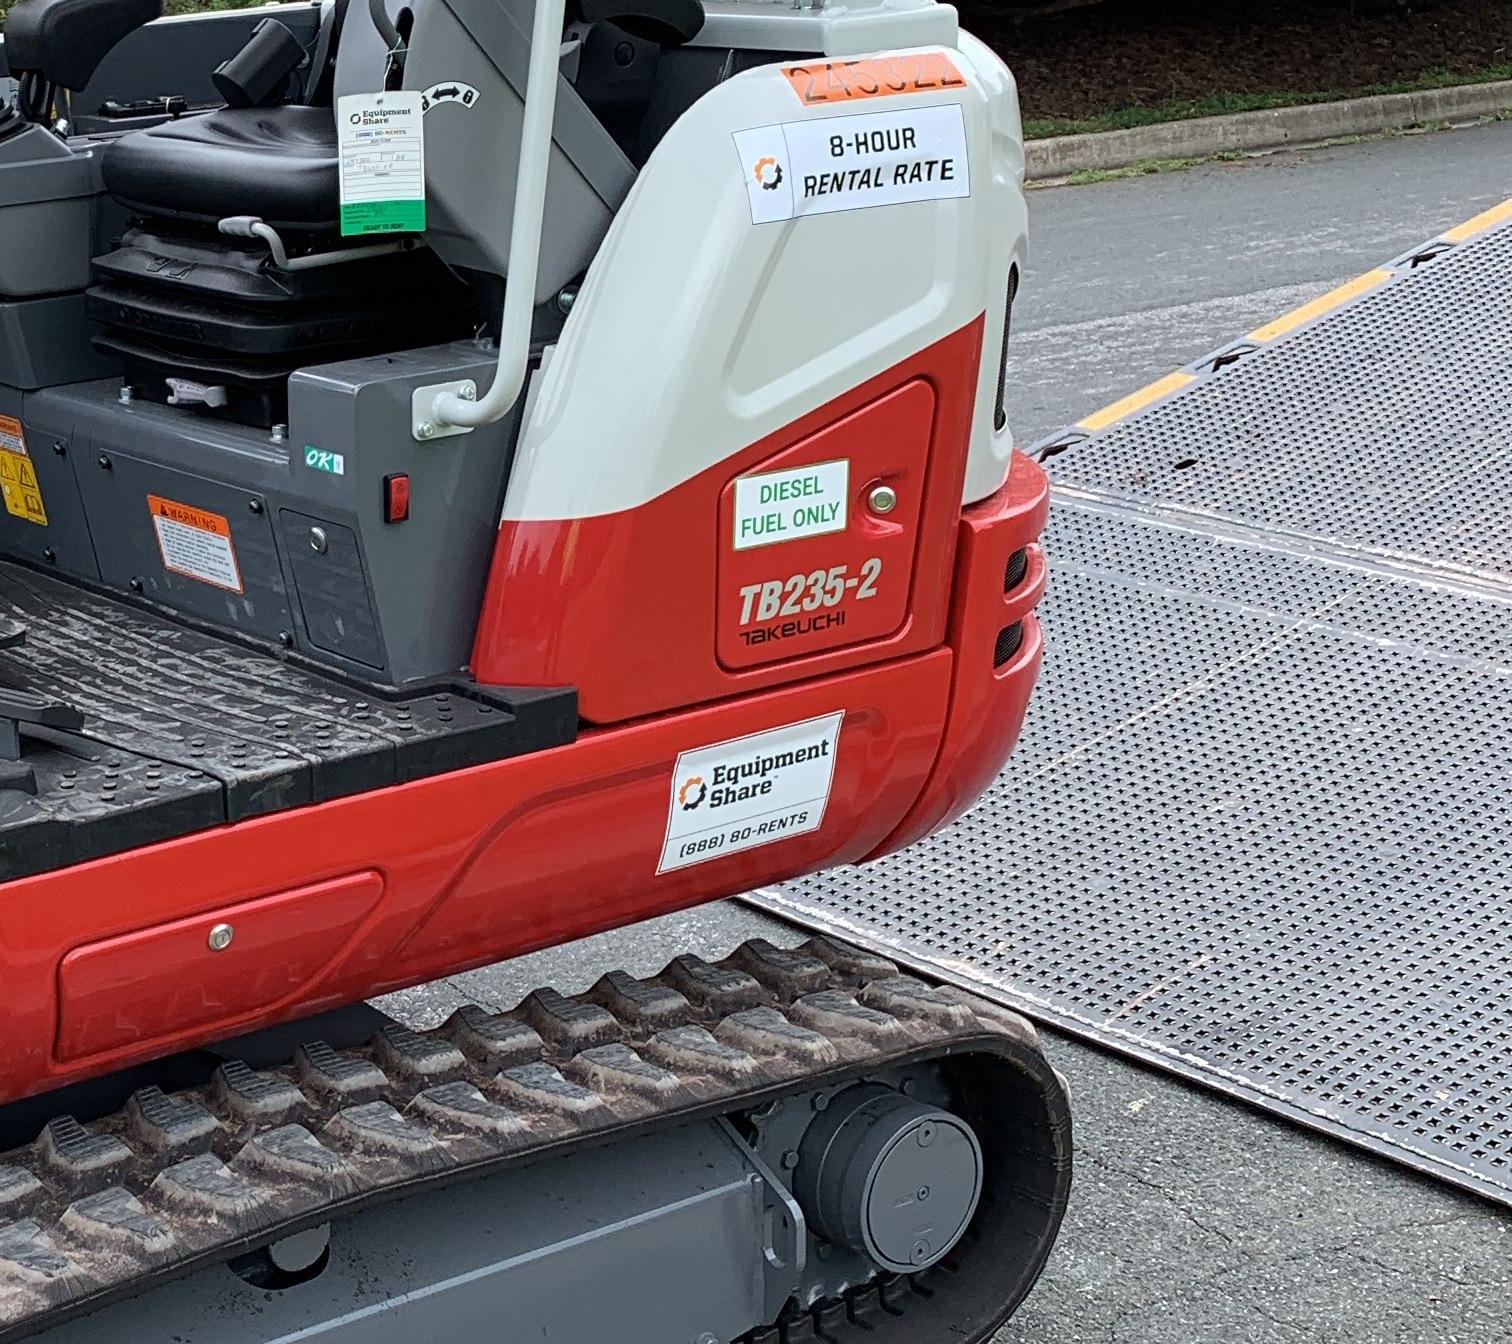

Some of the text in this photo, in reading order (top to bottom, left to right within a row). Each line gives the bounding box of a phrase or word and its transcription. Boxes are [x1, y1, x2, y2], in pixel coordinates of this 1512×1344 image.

[830, 127, 916, 157] 8-HOUR
[804, 159, 954, 198] RENTAL RATE
[305, 449, 333, 471] OK
[759, 476, 824, 504] DIESEL
[741, 501, 841, 538] FUEL ONLY
[739, 558, 882, 626] TB235-2
[712, 740, 829, 786] Equipment
[709, 780, 772, 808] Share
[679, 812, 808, 858] (888) 80-RENTS
